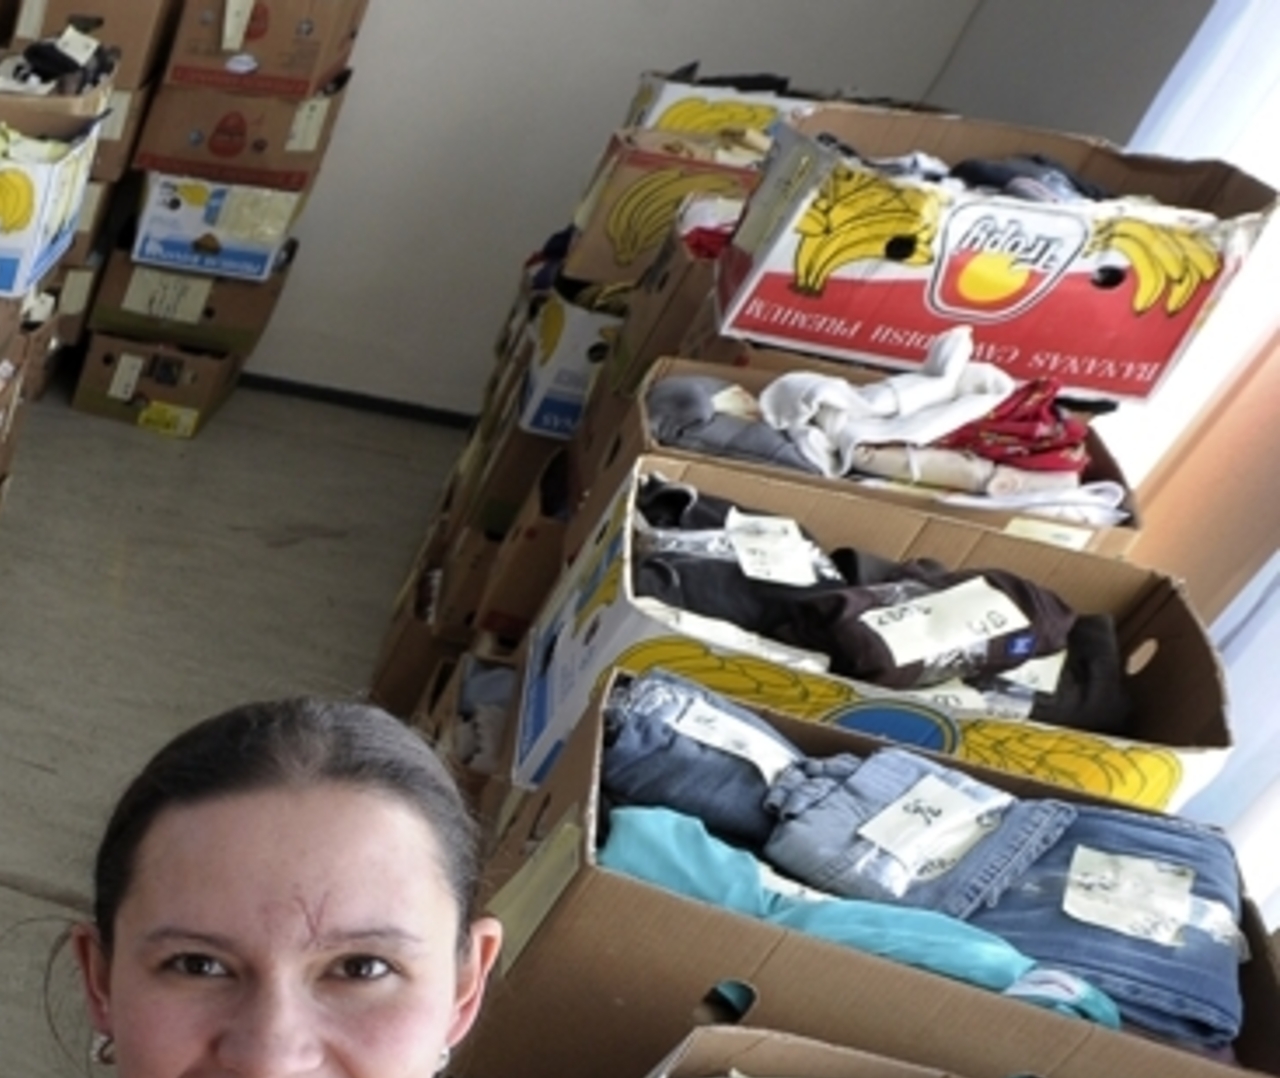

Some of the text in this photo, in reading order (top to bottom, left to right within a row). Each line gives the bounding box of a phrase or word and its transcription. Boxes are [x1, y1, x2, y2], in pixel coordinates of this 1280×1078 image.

[957, 213, 1065, 270] Tropy
[744, 296, 861, 338] PREMIUM
[1027, 353, 1161, 382] BANANAS
